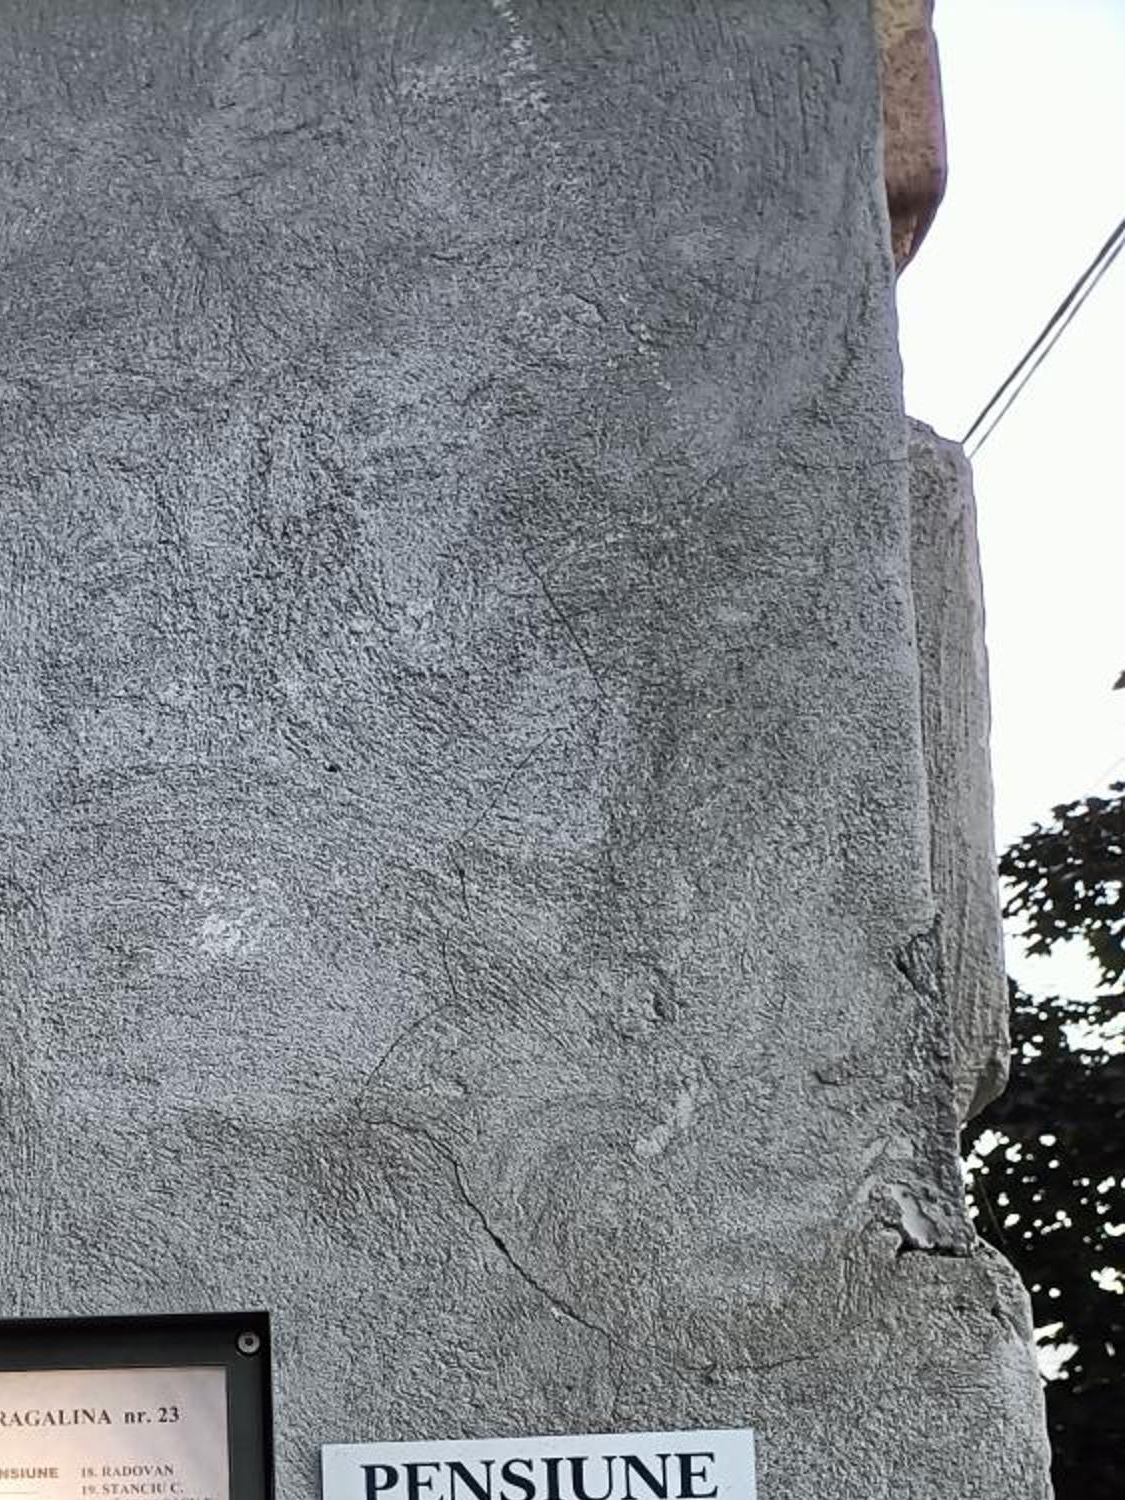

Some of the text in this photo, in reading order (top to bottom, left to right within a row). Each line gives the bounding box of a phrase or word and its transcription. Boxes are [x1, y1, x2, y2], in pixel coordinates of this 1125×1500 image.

[124, 1407, 153, 1426] nr.
[158, 1407, 180, 1424] 23
[102, 1465, 175, 1477] RADOVAN
[102, 1484, 166, 1495] STANCIU
